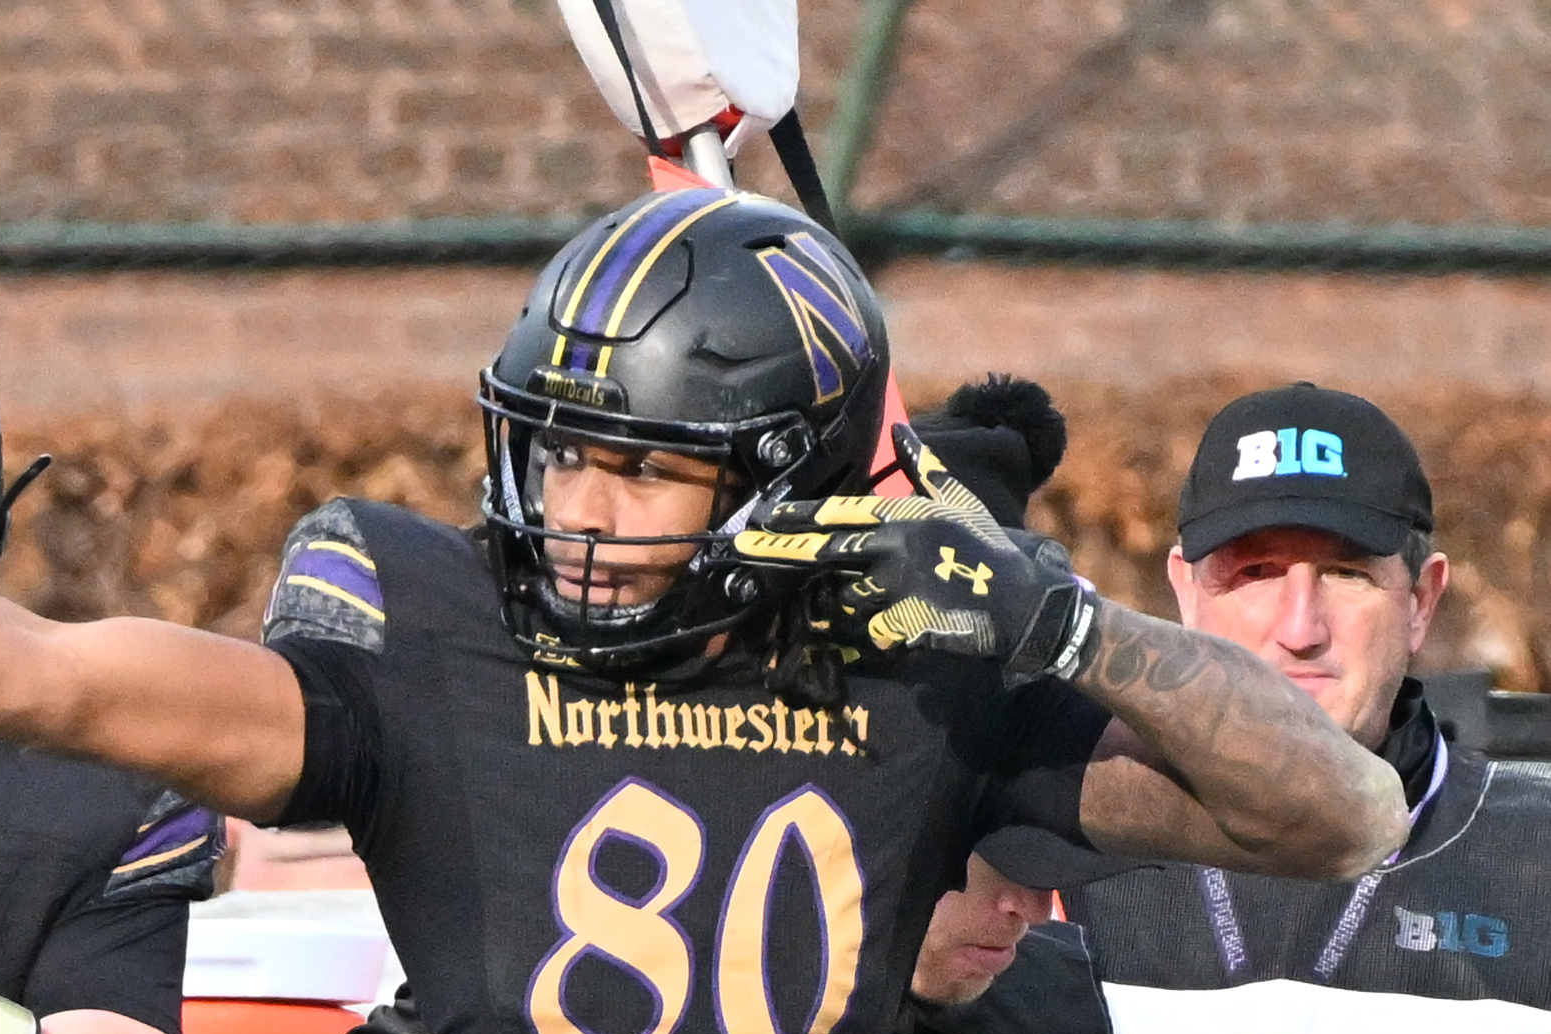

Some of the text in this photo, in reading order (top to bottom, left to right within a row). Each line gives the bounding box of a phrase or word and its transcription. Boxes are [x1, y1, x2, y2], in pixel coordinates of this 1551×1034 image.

[756, 231, 873, 404] N
[1232, 427, 1344, 481] B1G
[1393, 904, 1510, 958] B1G
